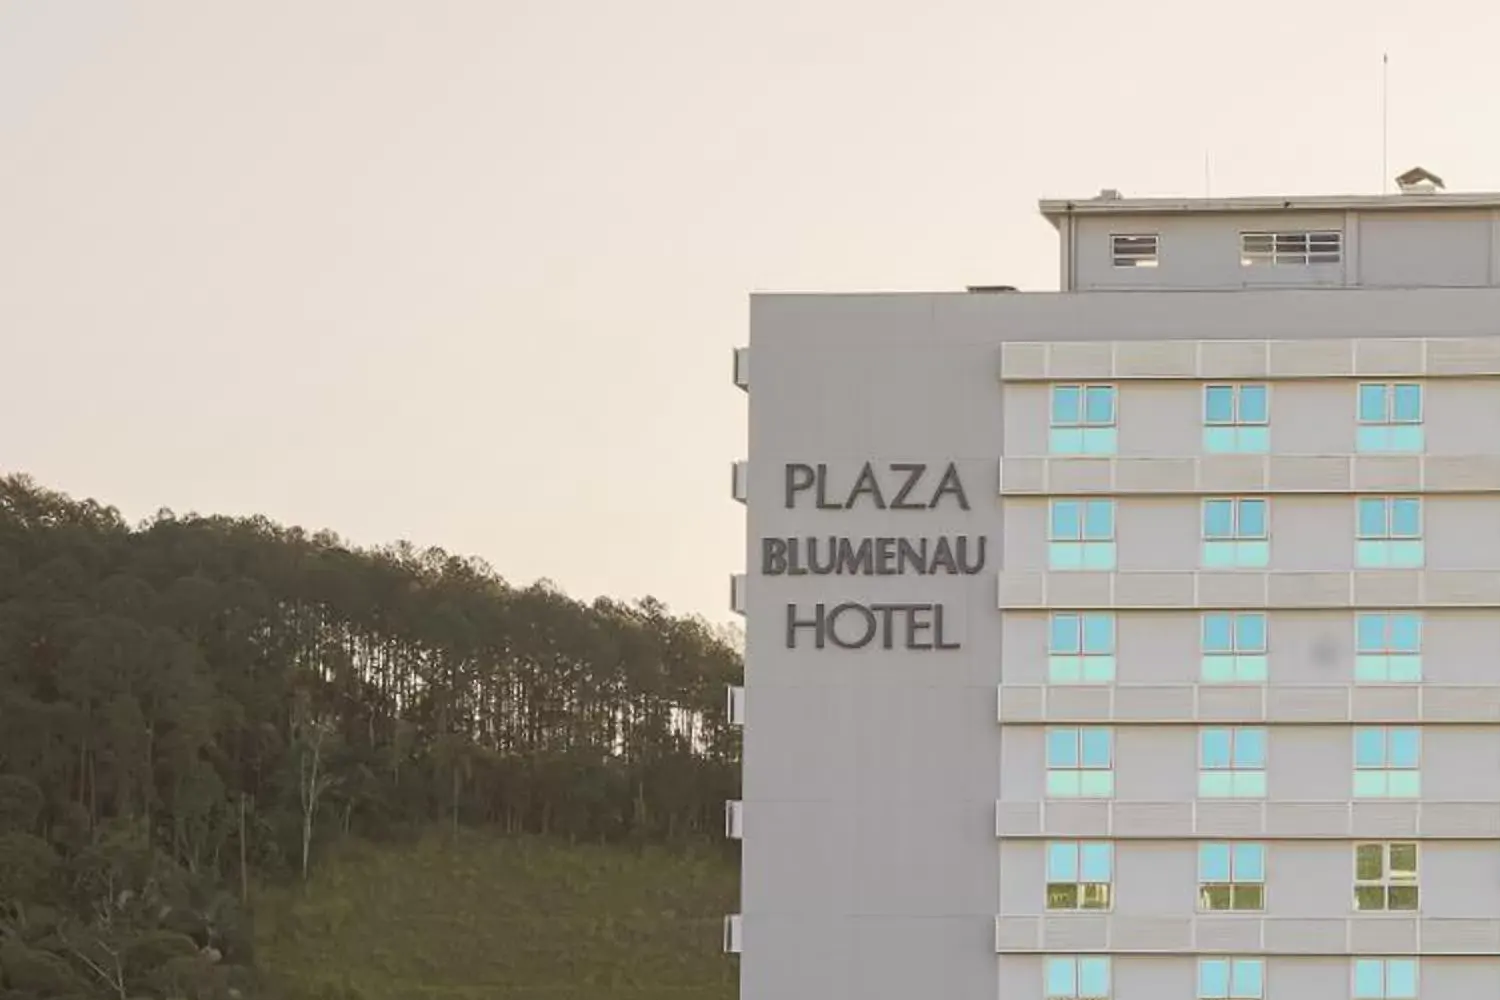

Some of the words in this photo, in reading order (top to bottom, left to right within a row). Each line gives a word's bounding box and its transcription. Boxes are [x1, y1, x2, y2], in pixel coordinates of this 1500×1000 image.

[785, 461, 971, 510] PLAZA
[761, 535, 987, 575] BLUMENAU
[785, 602, 961, 650] HOTEL
